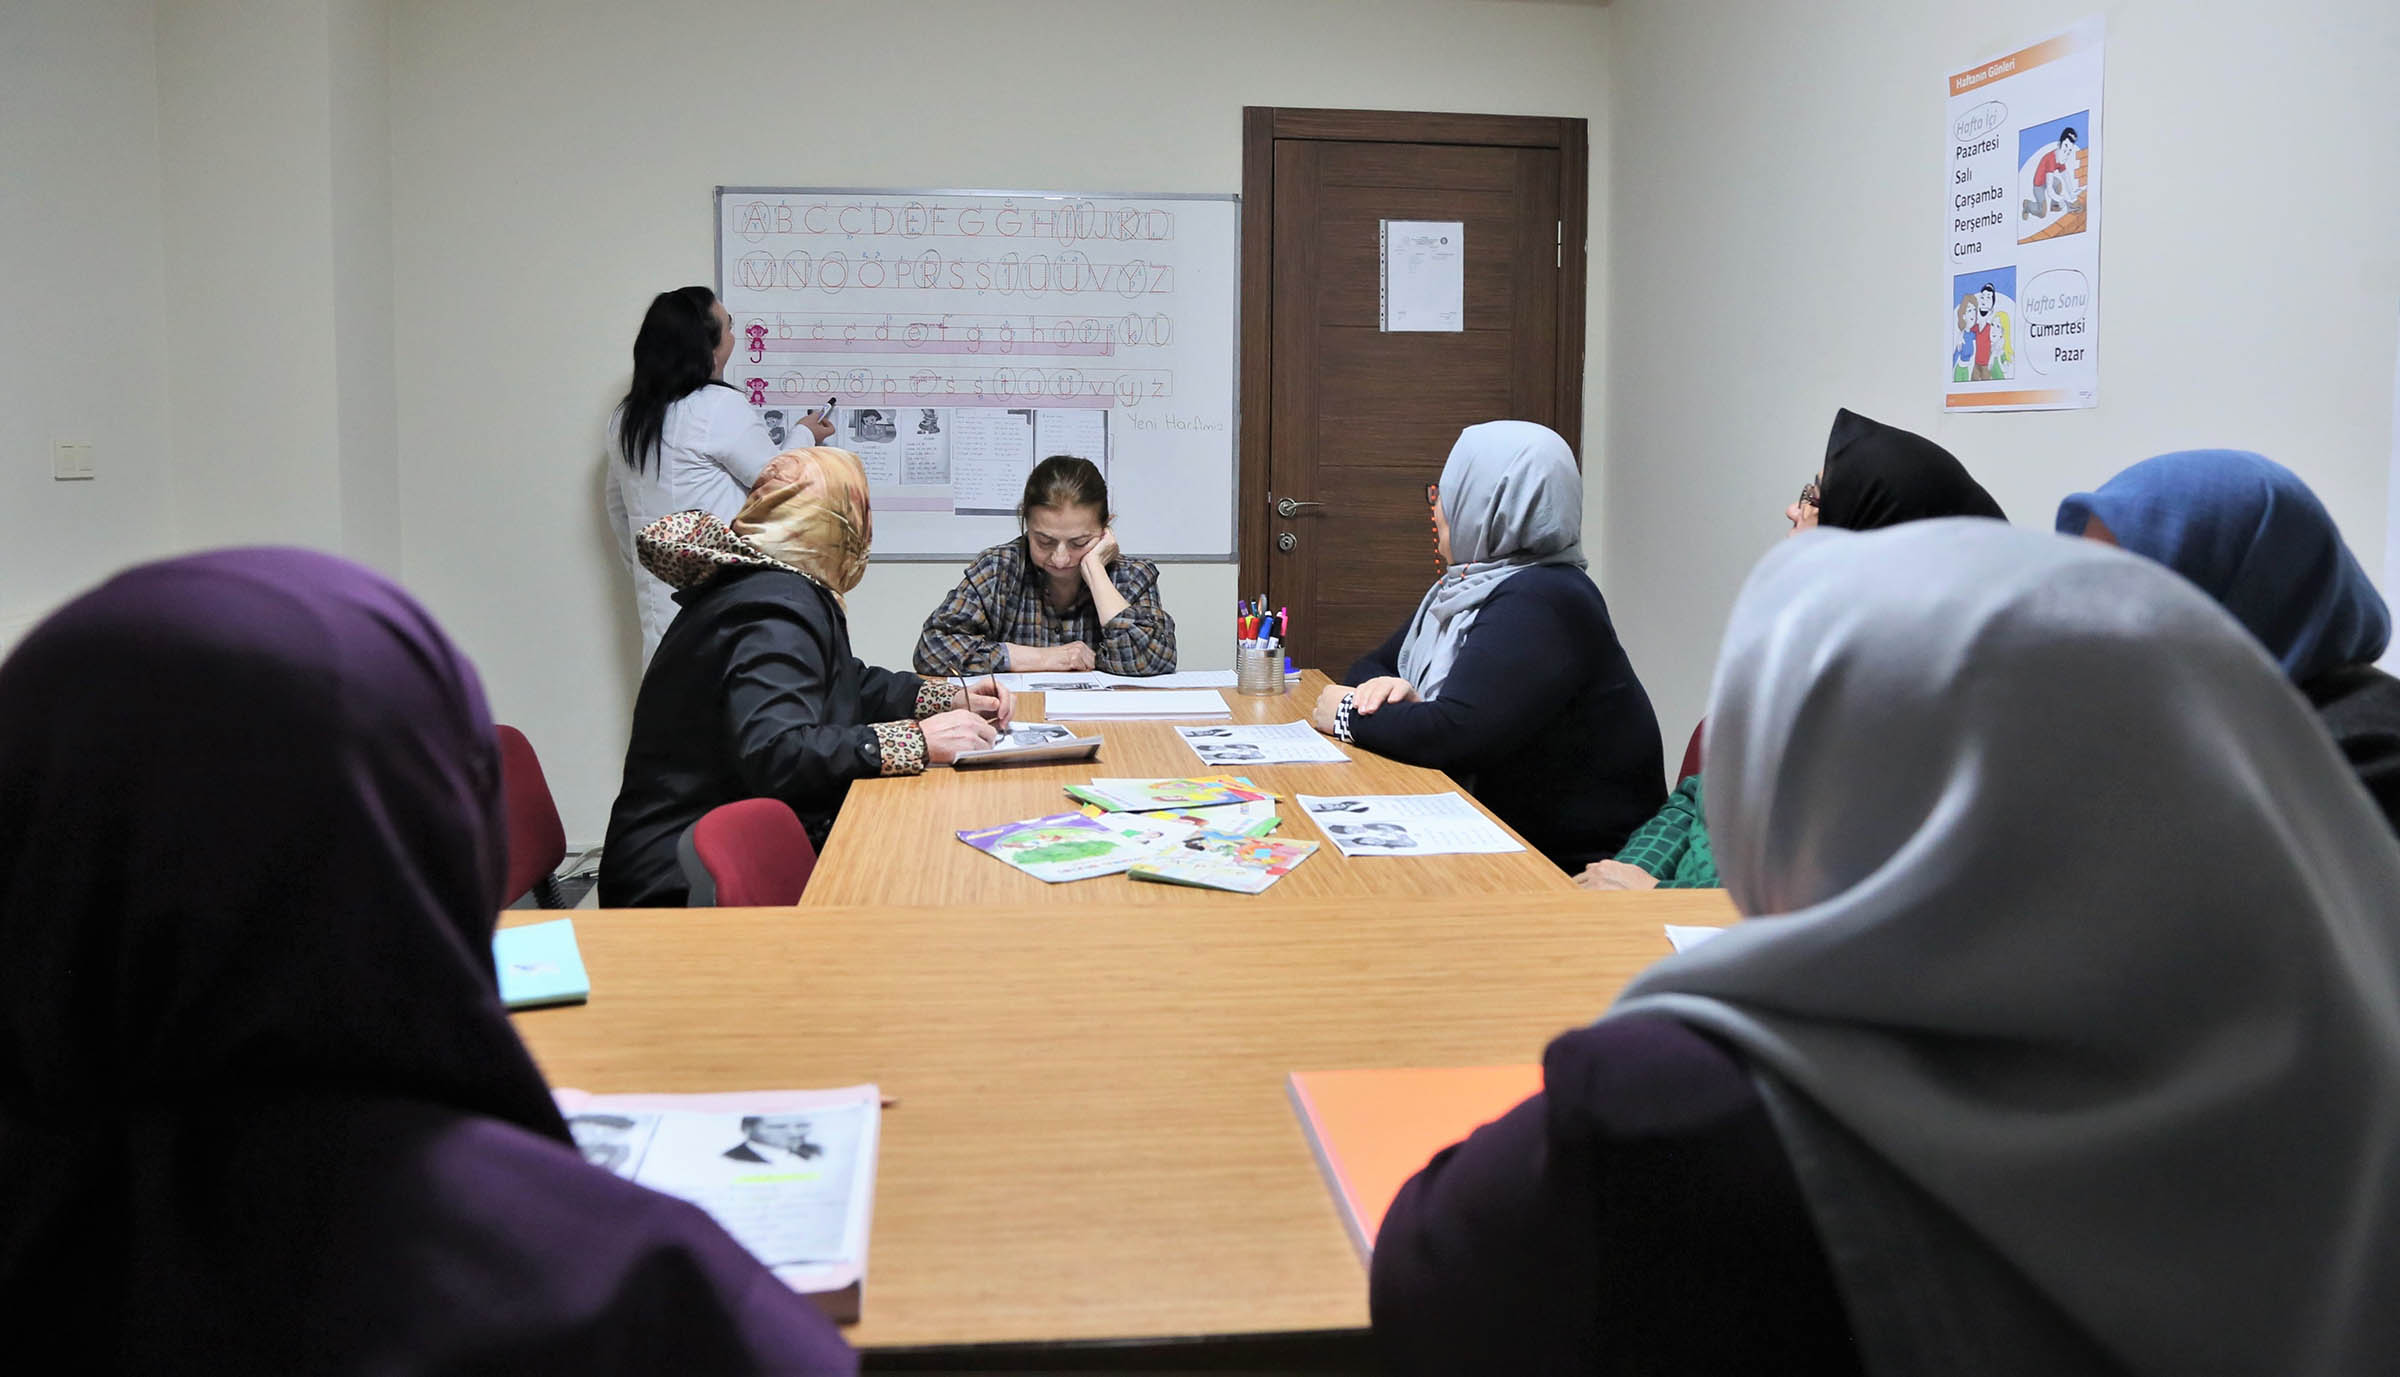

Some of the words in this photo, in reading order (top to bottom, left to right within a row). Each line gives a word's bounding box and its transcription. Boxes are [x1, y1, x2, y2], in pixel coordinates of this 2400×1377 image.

[1956, 67, 1987, 89] Haftanın
[1988, 58, 2016, 78] Günleri
[1956, 115, 1983, 136] Hafta
[1956, 135, 2000, 160] Pazartesi
[1955, 168, 1972, 184] Salı
[1955, 186, 2003, 211] Çarşamba
[1954, 211, 2003, 233] Perşembe
[1954, 241, 1982, 256] Cuma
[2025, 297, 2055, 315] Hafta
[2058, 293, 2087, 309] Sonu
[2030, 318, 2086, 338] Cumartesi
[2055, 347, 2085, 362] Pazar
